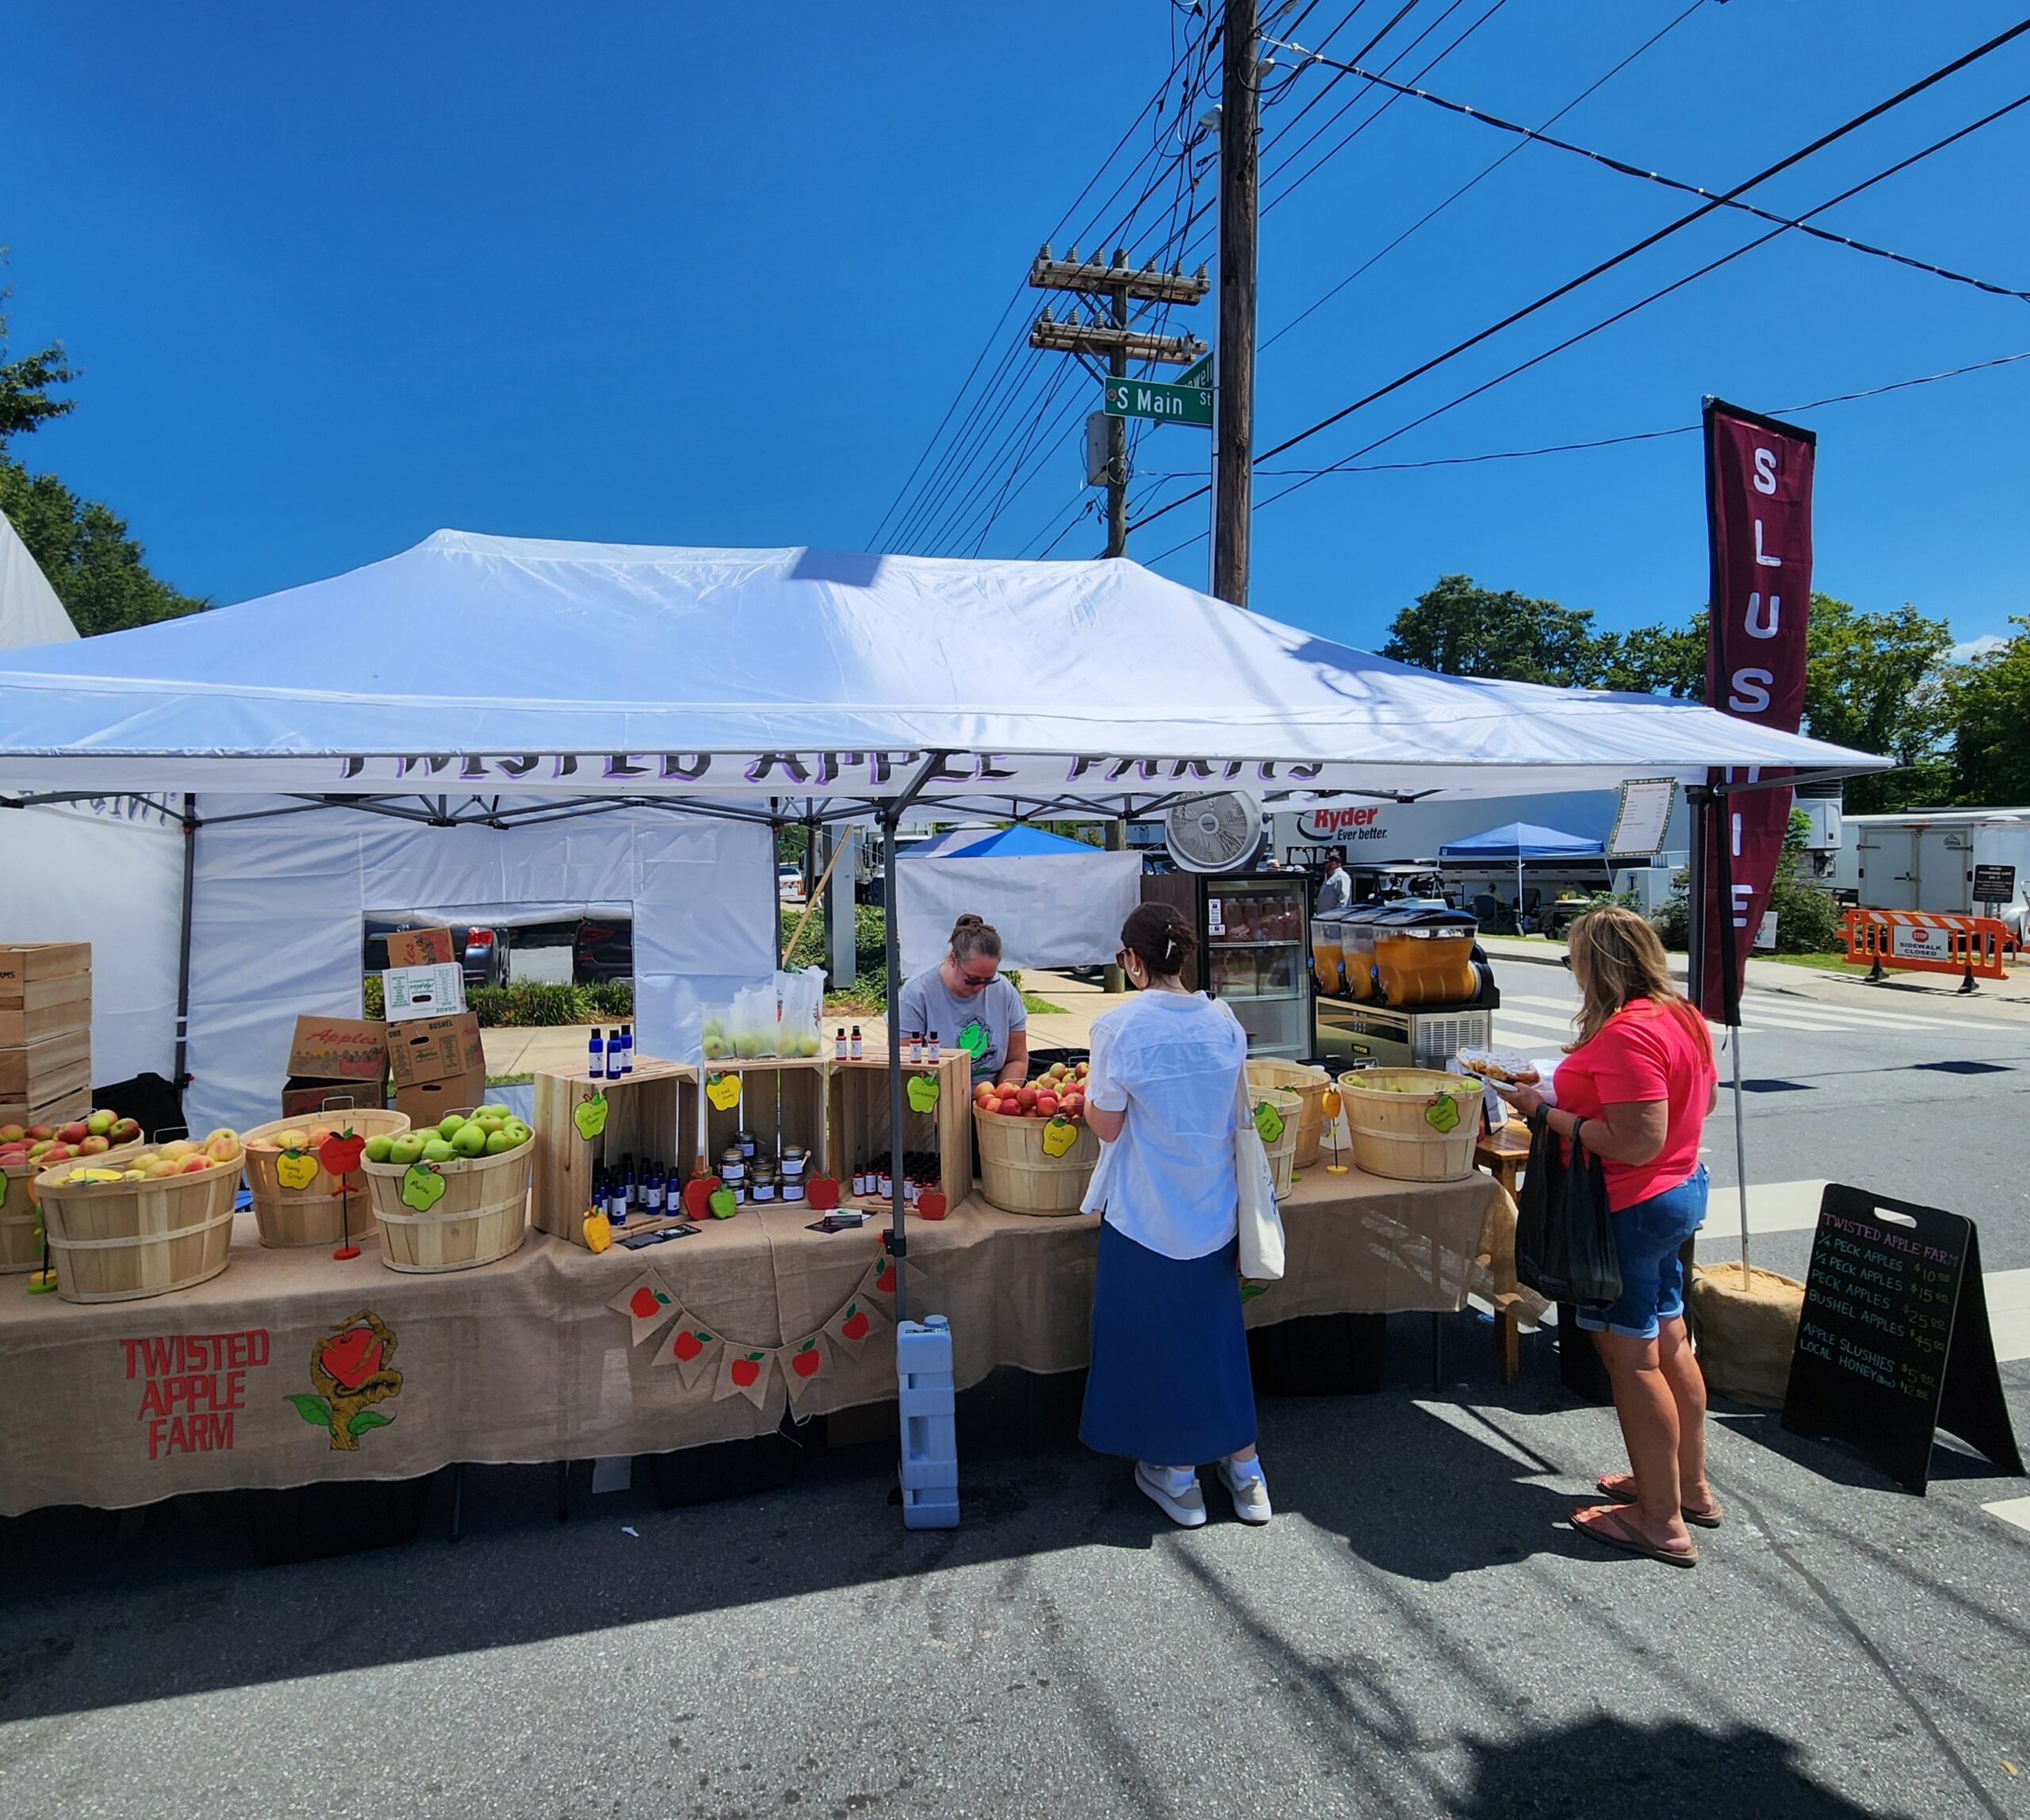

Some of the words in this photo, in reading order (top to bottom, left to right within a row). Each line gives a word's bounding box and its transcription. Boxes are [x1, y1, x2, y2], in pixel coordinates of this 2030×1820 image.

[1116, 386, 1128, 409] S
[1137, 388, 1182, 415] Main
[1199, 392, 1212, 406] St
[1313, 807, 1378, 833] Ryder
[1337, 829, 1357, 841] Ever
[1358, 827, 1388, 840] better.
[1900, 942, 1942, 951] SIDEWALK
[305, 1029, 379, 1045] Apples
[388, 1029, 402, 1038] ONE
[428, 1019, 454, 1031] BUSHEL
[1823, 1213, 1881, 1242] TWISTED
[1883, 1233, 1920, 1255] APPLE
[1923, 1246, 1959, 1267] FARM
[1834, 1238, 1860, 1257] PECK
[1863, 1250, 1903, 1272] APPLES
[1811, 1269, 1840, 1292] PECK
[1846, 1283, 1891, 1309] APPLES
[1829, 1257, 1856, 1276] PECK
[1860, 1269, 1903, 1292] APPLES
[1808, 1289, 1856, 1319] BUSHEL
[1861, 1310, 1904, 1337] APPLES
[121, 1328, 270, 1381] TWISTED
[1800, 1338, 1832, 1361] LOCAL
[1839, 1354, 1878, 1381] HONEY
[1802, 1322, 1837, 1346] APPLE
[1839, 1338, 1895, 1373] SLUSHIES
[136, 1370, 247, 1421] APPLE
[147, 1412, 234, 1460] FARM
